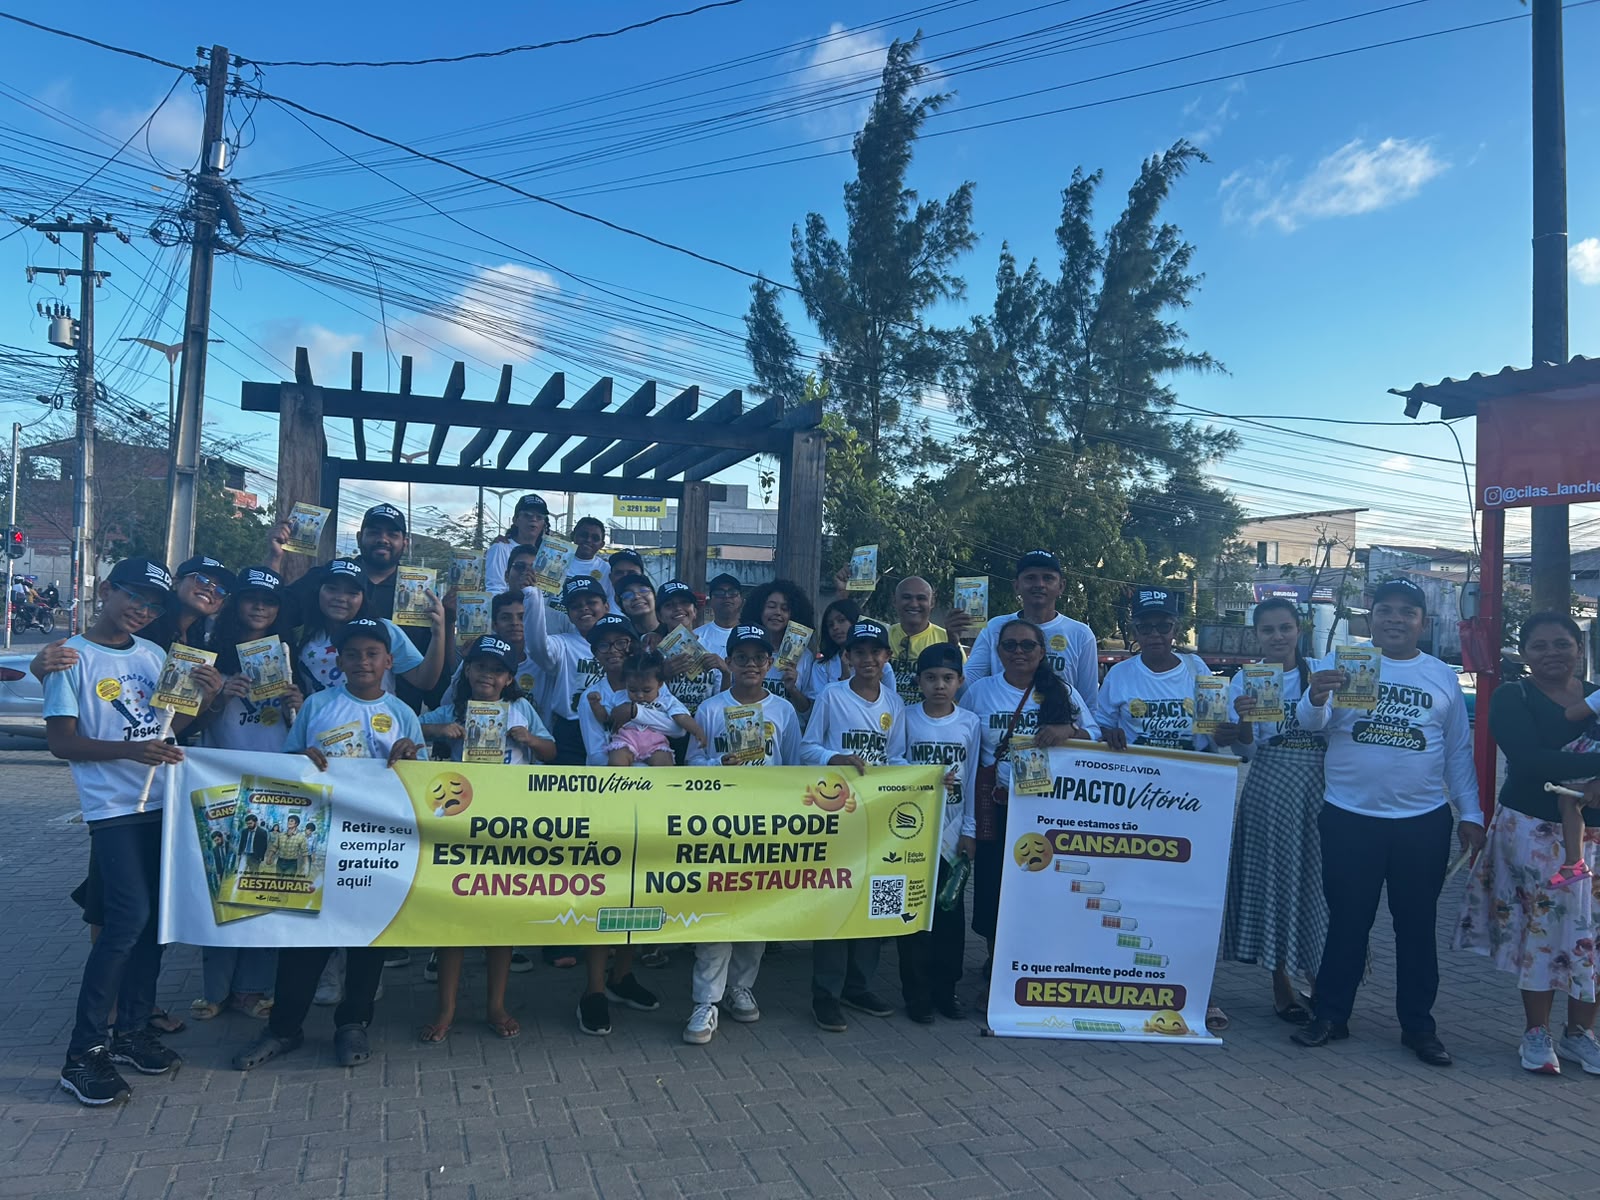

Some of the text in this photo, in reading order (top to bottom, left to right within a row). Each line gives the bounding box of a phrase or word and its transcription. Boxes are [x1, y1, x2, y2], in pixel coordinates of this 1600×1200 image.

[346, 561, 361, 572] DP
[265, 573, 279, 585] DP
[577, 579, 591, 587] DP
[677, 582, 689, 590] DP
[1153, 591, 1167, 600] DP
[359, 618, 377, 626] DP
[607, 616, 622, 624] DP
[751, 626, 764, 636] DP
[868, 624, 881, 634] DP
[495, 639, 511, 651] DP
[1378, 685, 1432, 709] PACTO
[240, 711, 261, 726] Jes
[1142, 714, 1190, 732] Vitória
[1374, 715, 1409, 726] 2026
[842, 732, 888, 752] IMPAC
[1357, 732, 1421, 749] CANSADOS
[1074, 759, 1161, 776] #TODOSPELAVIDA
[528, 773, 721, 793] IMPACTO Vitória 2026
[252, 794, 307, 805] CANSADOS
[1036, 776, 1203, 812] MPACTO Vitória
[209, 807, 235, 819] CANS
[342, 821, 412, 835] Retire seu
[469, 817, 590, 841] POR QUE
[667, 814, 839, 839] E O QUE PODE
[1037, 815, 1138, 831] Por que estamos tão
[340, 840, 406, 854] exemplar
[676, 841, 827, 864] REALMENTE
[1055, 833, 1179, 858] CANSADOS
[432, 841, 622, 866] ESTAMOS TÃO
[338, 857, 399, 871] gratuito
[239, 879, 311, 892] RESTAURAR
[336, 875, 372, 888] aqui!
[451, 873, 606, 897] CANSADOS
[645, 868, 853, 894] NOS RESTAURAR
[1012, 961, 1166, 979] E o que realmente pode nos
[1026, 982, 1175, 1007] RESTAURAR
